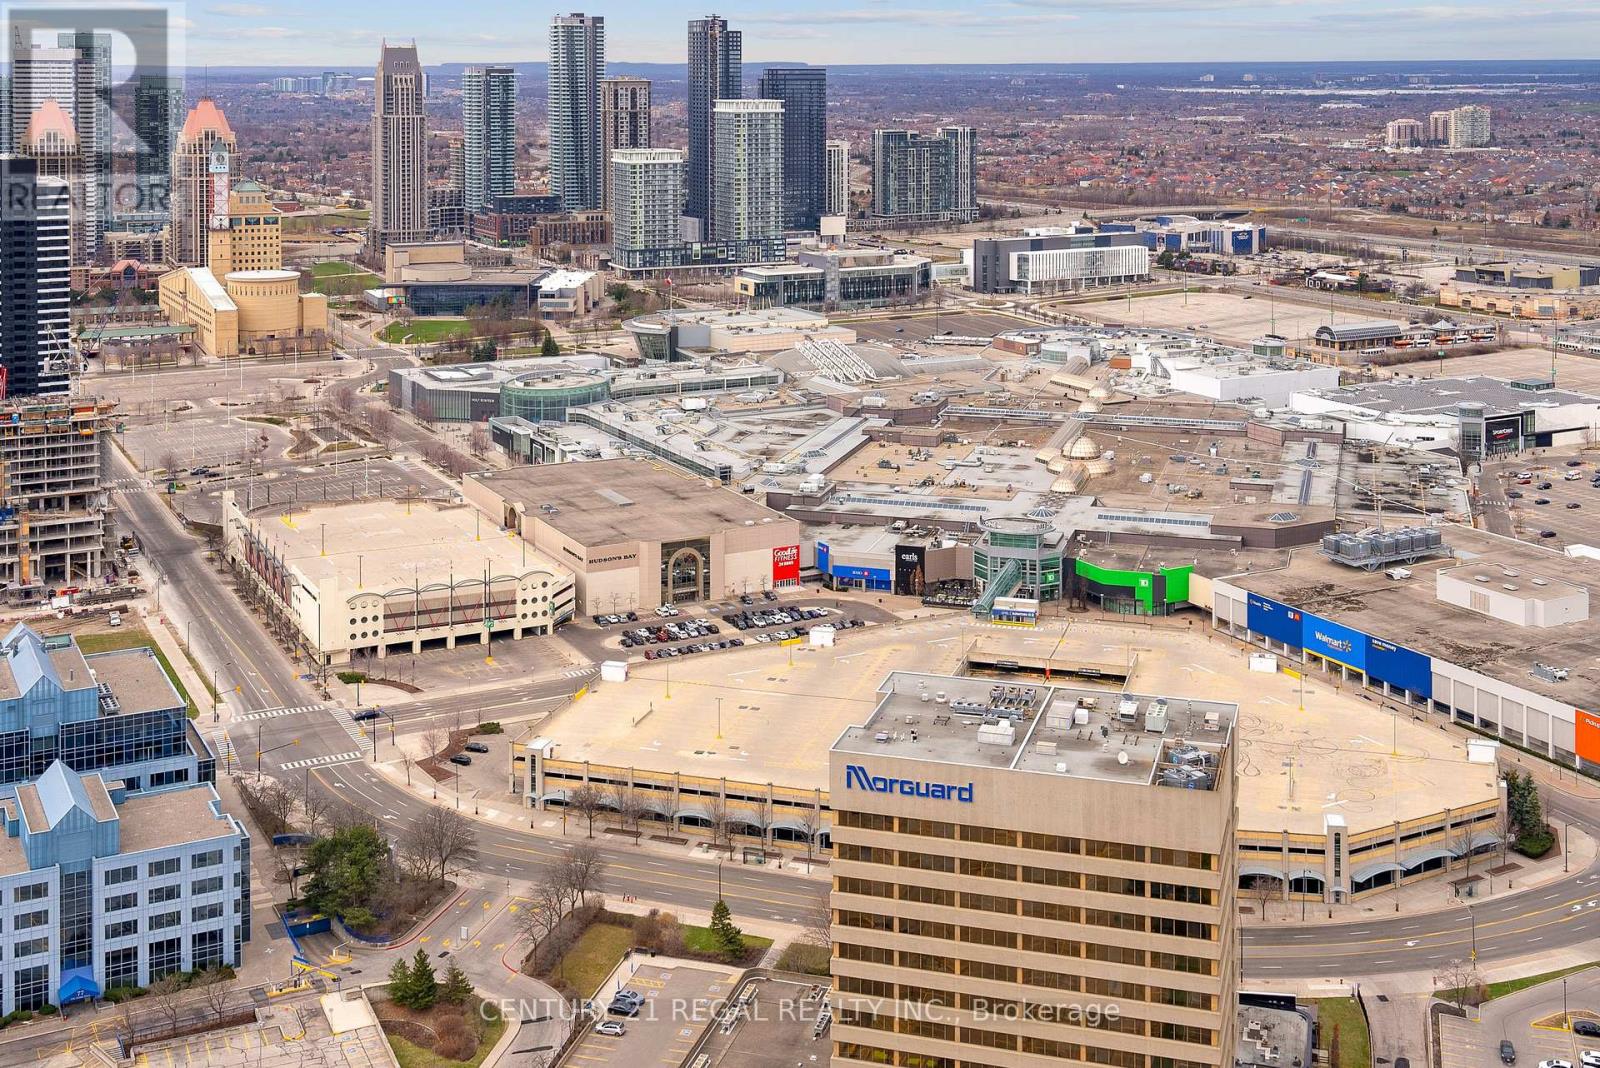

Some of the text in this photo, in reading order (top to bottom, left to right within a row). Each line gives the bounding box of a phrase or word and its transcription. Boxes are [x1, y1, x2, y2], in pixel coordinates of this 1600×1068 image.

[901, 552, 918, 561] earls
[1314, 630, 1343, 648] Walmart
[846, 764, 974, 803] Morguard
